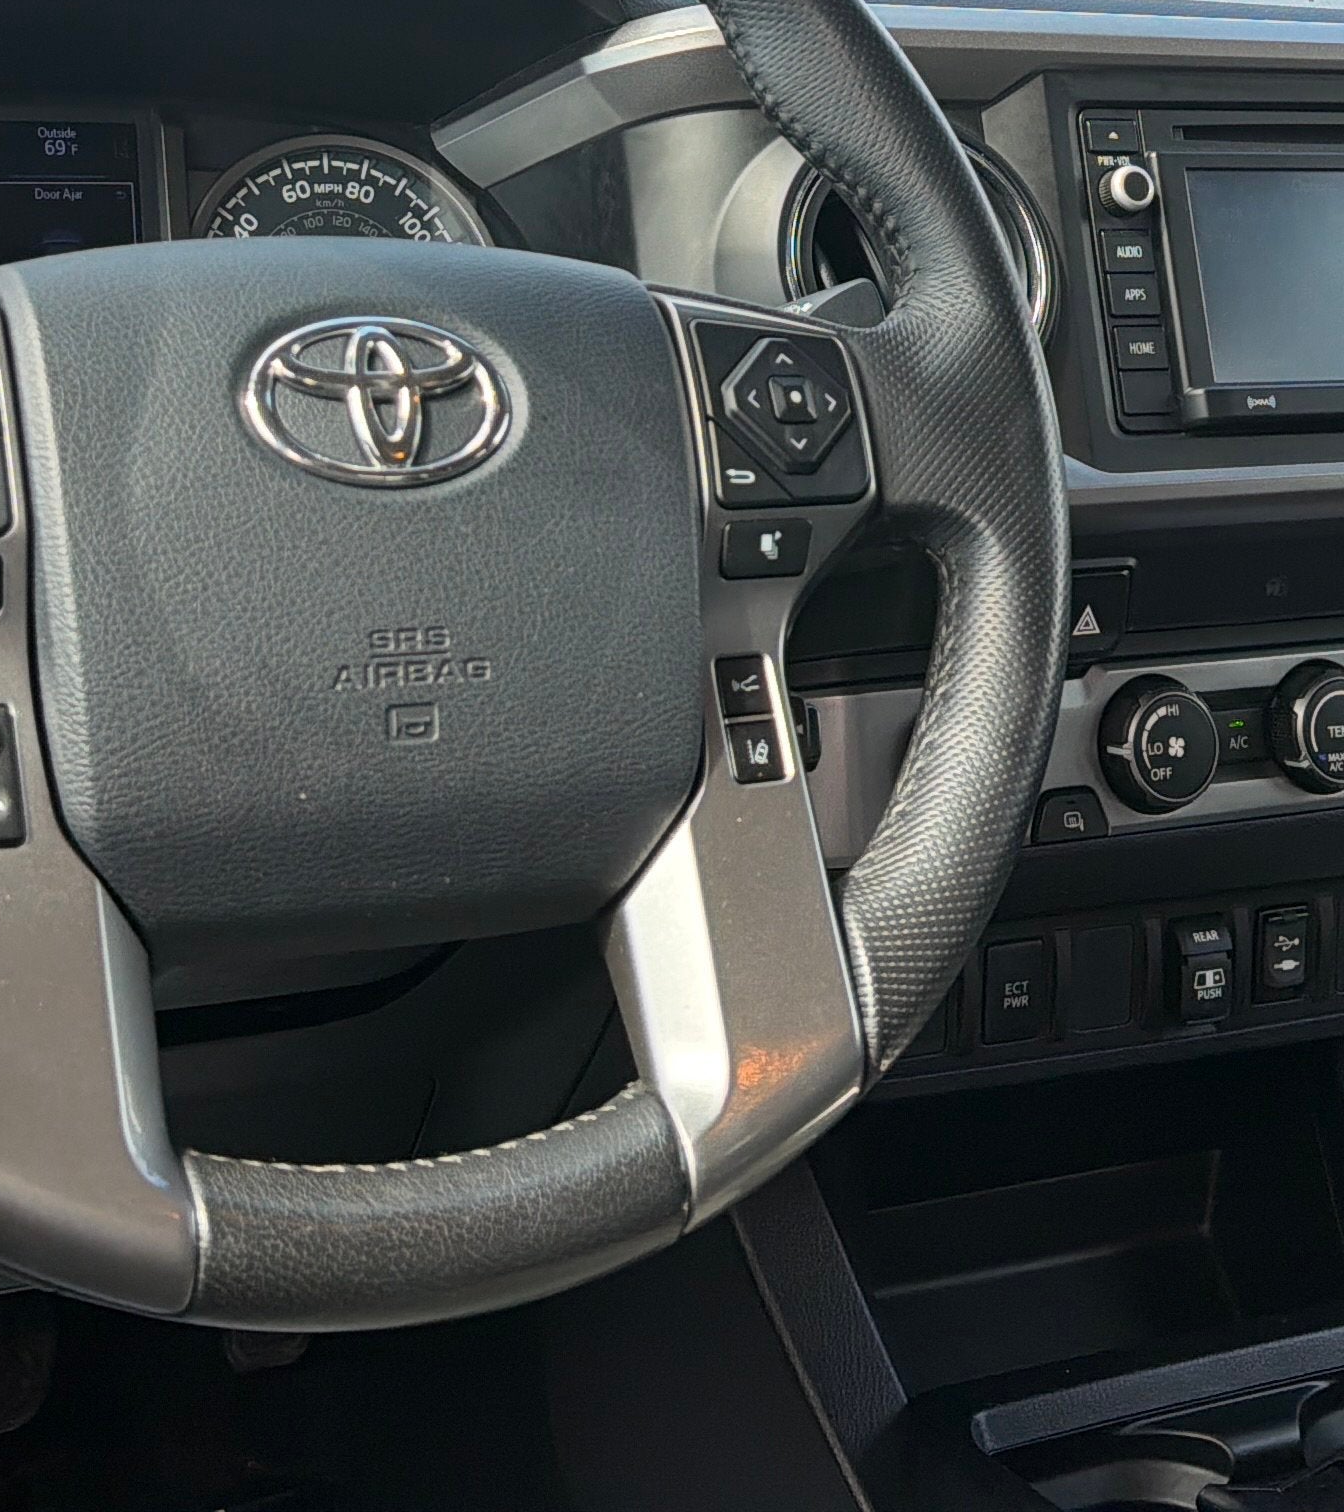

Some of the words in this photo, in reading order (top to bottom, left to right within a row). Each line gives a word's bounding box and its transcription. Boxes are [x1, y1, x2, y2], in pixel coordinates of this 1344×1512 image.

[37, 127, 77, 139] Outside
[34, 188, 61, 200] Door
[62, 188, 84, 201] Ajar
[282, 180, 312, 204] 60
[313, 183, 343, 195] MPH
[345, 181, 375, 204] 80
[315, 198, 345, 208] km/h
[302, 215, 325, 229] 100
[332, 214, 353, 228] 120
[399, 211, 432, 243] 100
[1116, 246, 1143, 258] AUDIO
[1124, 289, 1147, 301] APPS
[1129, 343, 1155, 355] HOME
[368, 625, 452, 652] SRS
[332, 656, 493, 691] AIRBAG
[1167, 704, 1180, 716] HI
[1147, 742, 1164, 756] LO
[1229, 736, 1249, 750] A/C
[1150, 767, 1173, 781] OFF
[1329, 762, 1344, 772] A/C
[1192, 930, 1220, 944] REAR
[1005, 981, 1030, 995] ECT
[1197, 988, 1223, 1001] PUSH
[1004, 995, 1030, 1009] PWR
